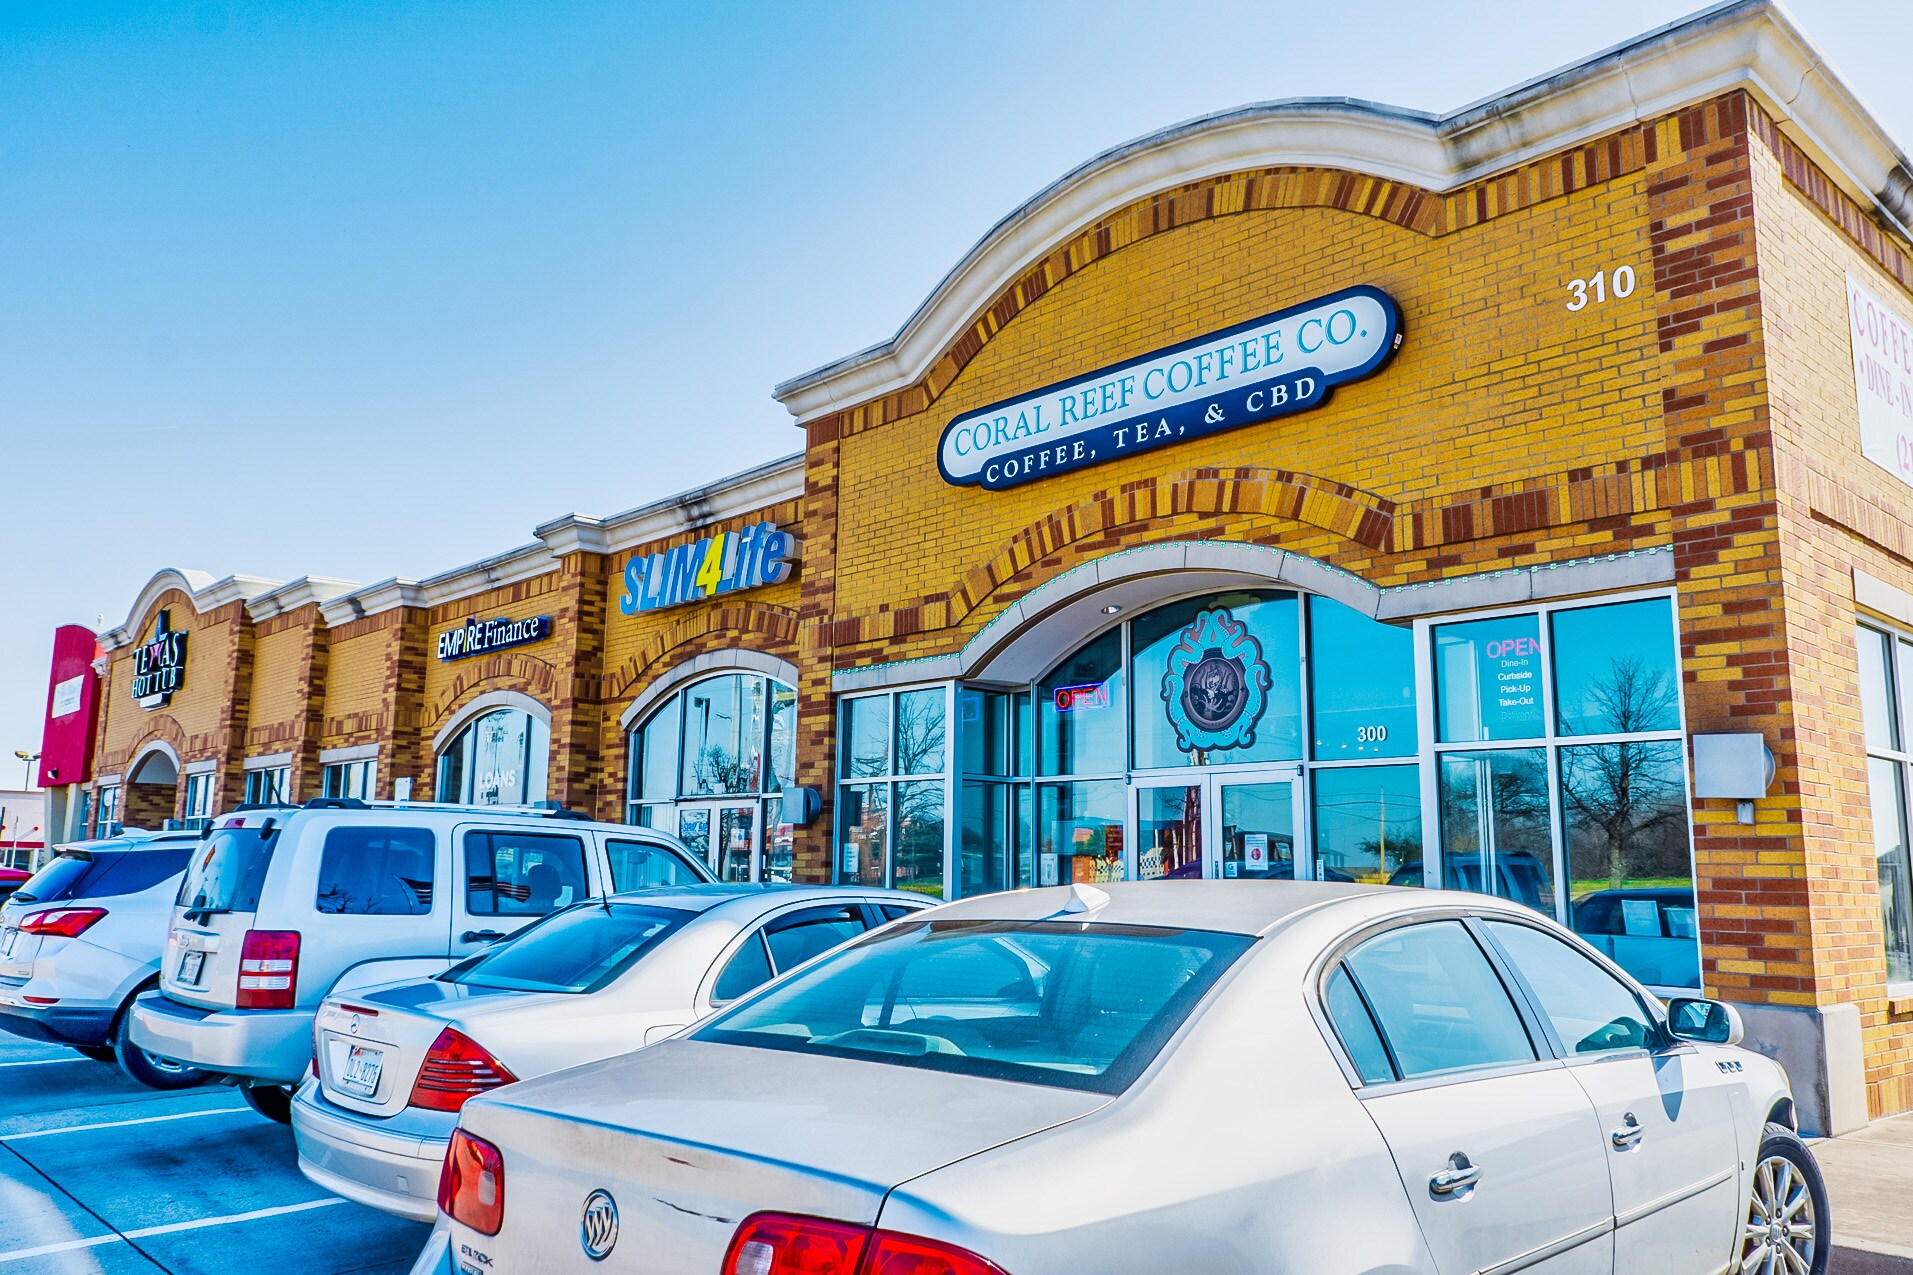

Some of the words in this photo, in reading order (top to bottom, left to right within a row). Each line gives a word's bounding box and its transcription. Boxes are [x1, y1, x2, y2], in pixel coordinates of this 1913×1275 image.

[1566, 265, 1635, 311] 310
[1853, 290, 1913, 376] COFFE
[954, 405, 1050, 456] CORAL
[1059, 376, 1136, 427] REEF
[1143, 330, 1284, 400] COFFEE
[1296, 309, 1367, 354] CO.
[986, 440, 1096, 483] COFFEE,
[1113, 417, 1185, 449] TEA,
[1204, 403, 1226, 424] &
[1246, 377, 1315, 412] CBD
[437, 624, 483, 659] EMPIRE
[482, 617, 539, 648] Finance
[1486, 637, 1542, 659] OPEN
[133, 633, 180, 676] TEXAS
[1501, 659, 1529, 668] Dine-In
[132, 675, 152, 698] HOT
[154, 667, 177, 692] TUB
[1498, 671, 1532, 681] Curbside
[1056, 687, 1107, 708] OPEN
[1500, 684, 1531, 693] Pick-Up
[1499, 697, 1534, 707] Take-Out
[1357, 725, 1387, 743] 300
[479, 769, 516, 790] LOANS
